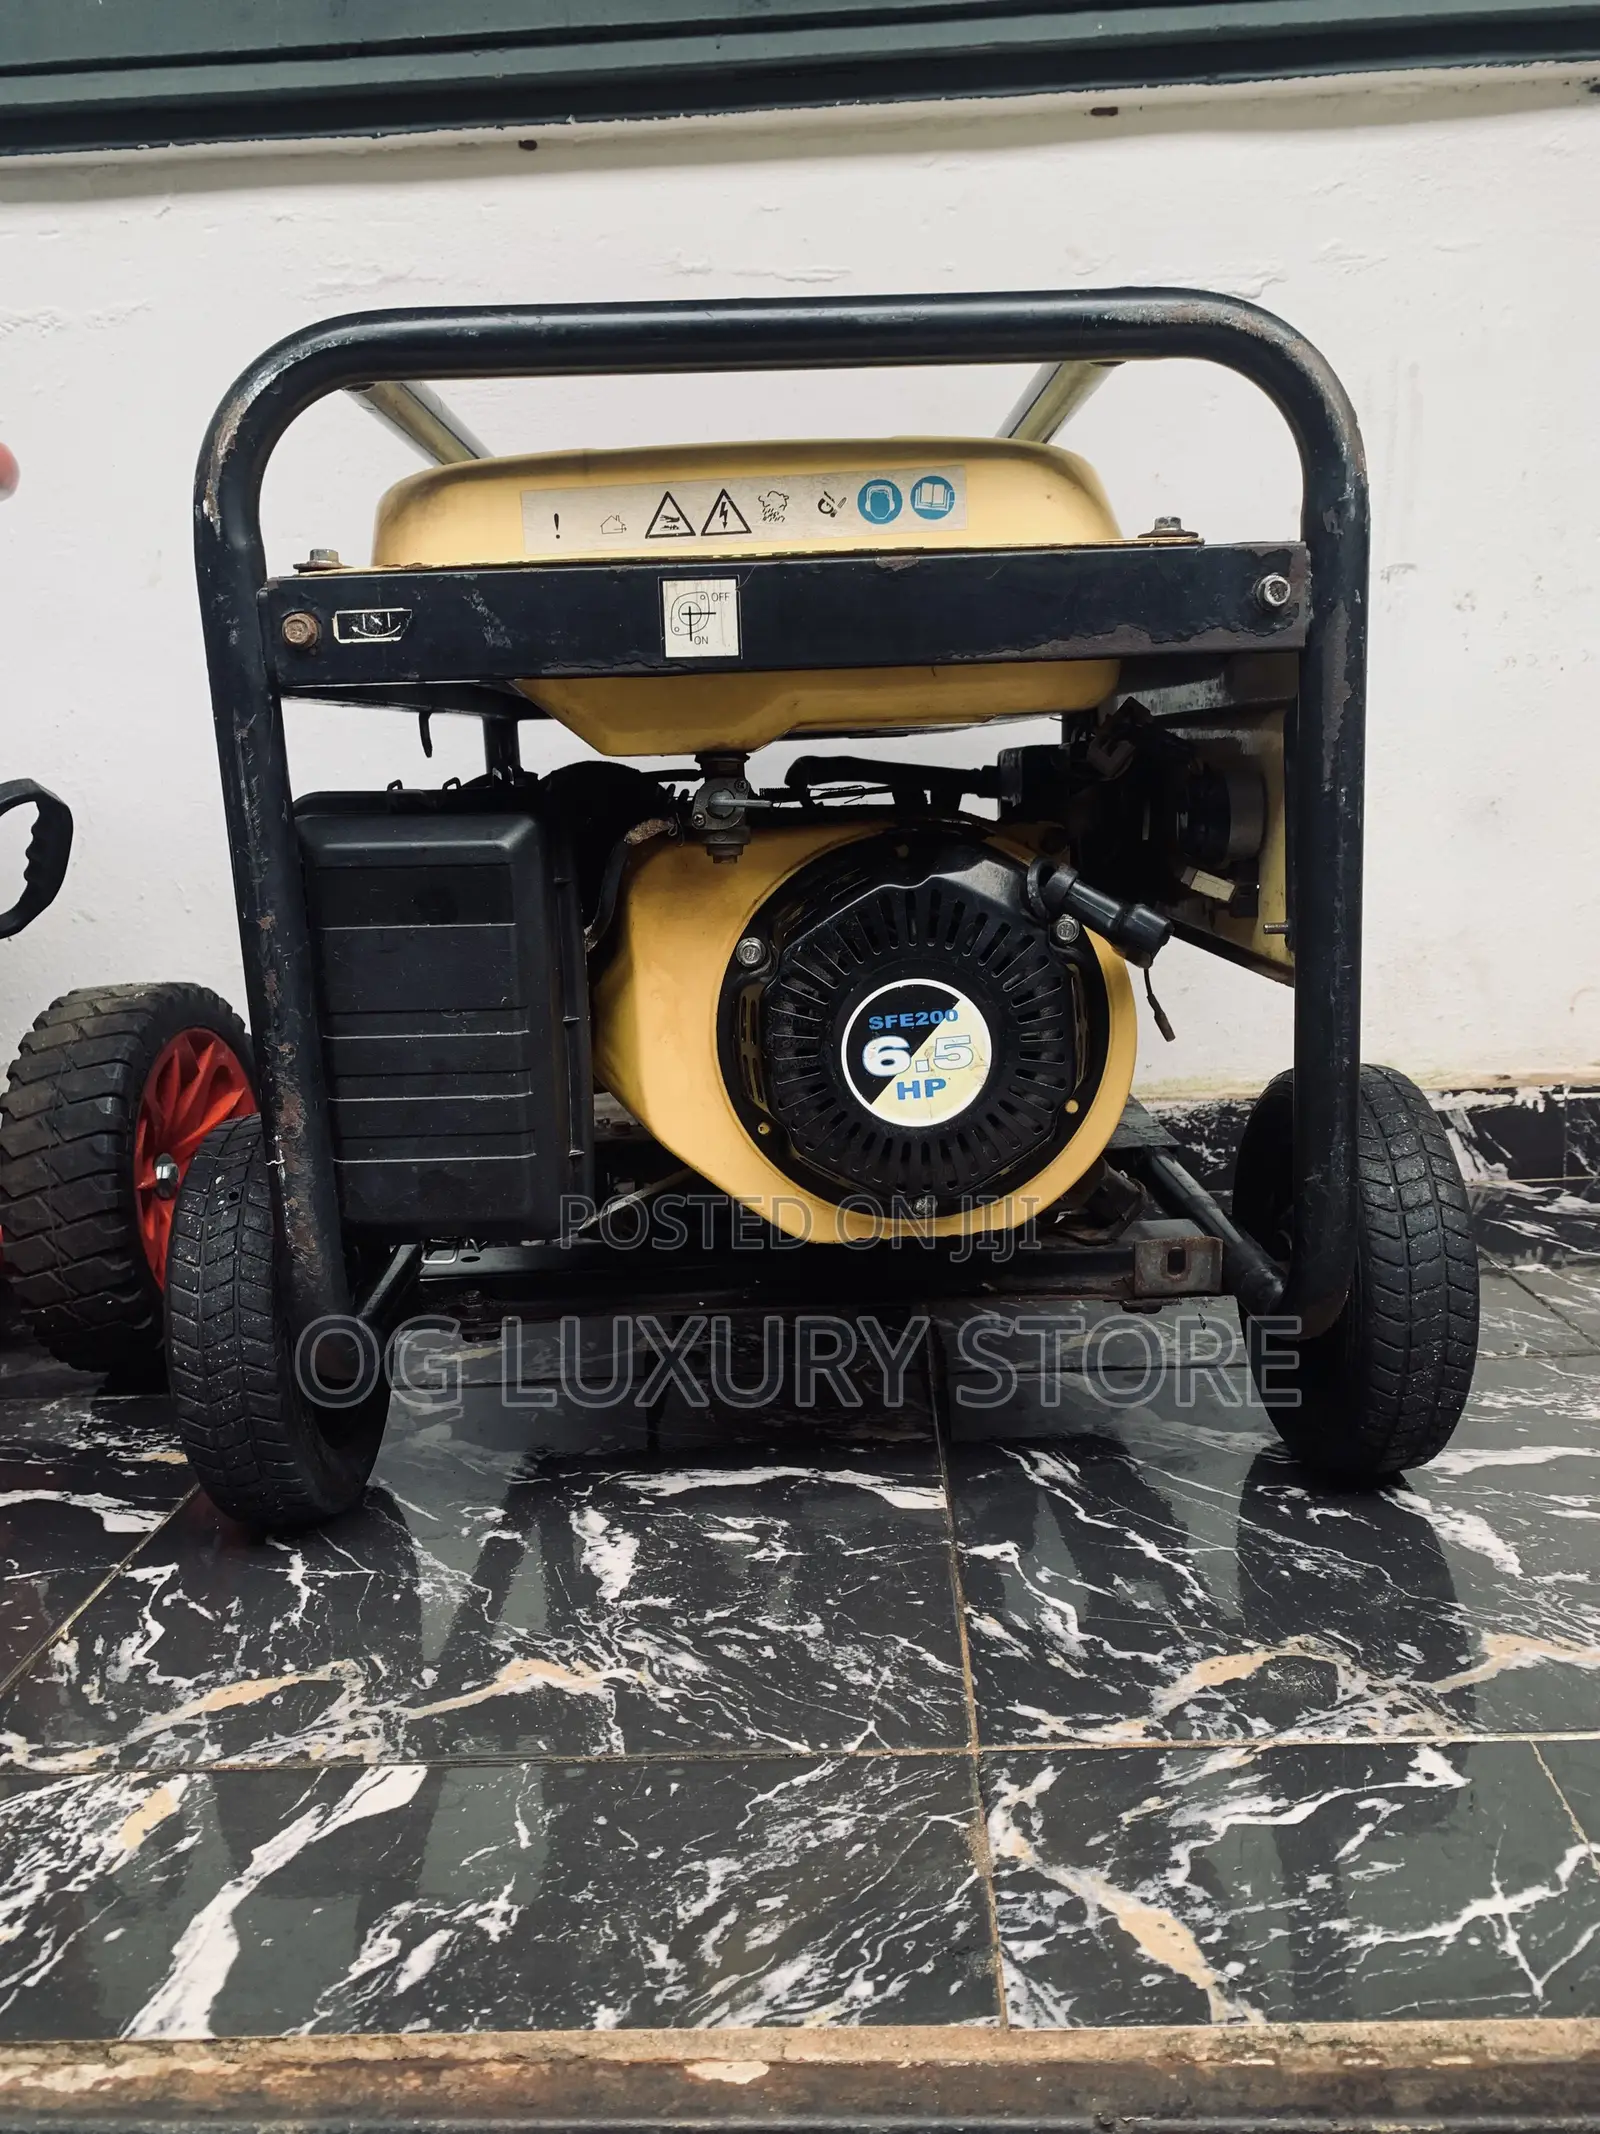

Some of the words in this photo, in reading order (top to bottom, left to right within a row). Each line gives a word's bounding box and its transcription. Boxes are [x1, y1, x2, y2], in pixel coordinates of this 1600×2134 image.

[711, 592, 731, 602] OFF
[694, 635, 709, 645] ON
[868, 1009, 959, 1030] SFE200
[862, 1035, 974, 1077] 6.5
[896, 1078, 947, 1101] HP
